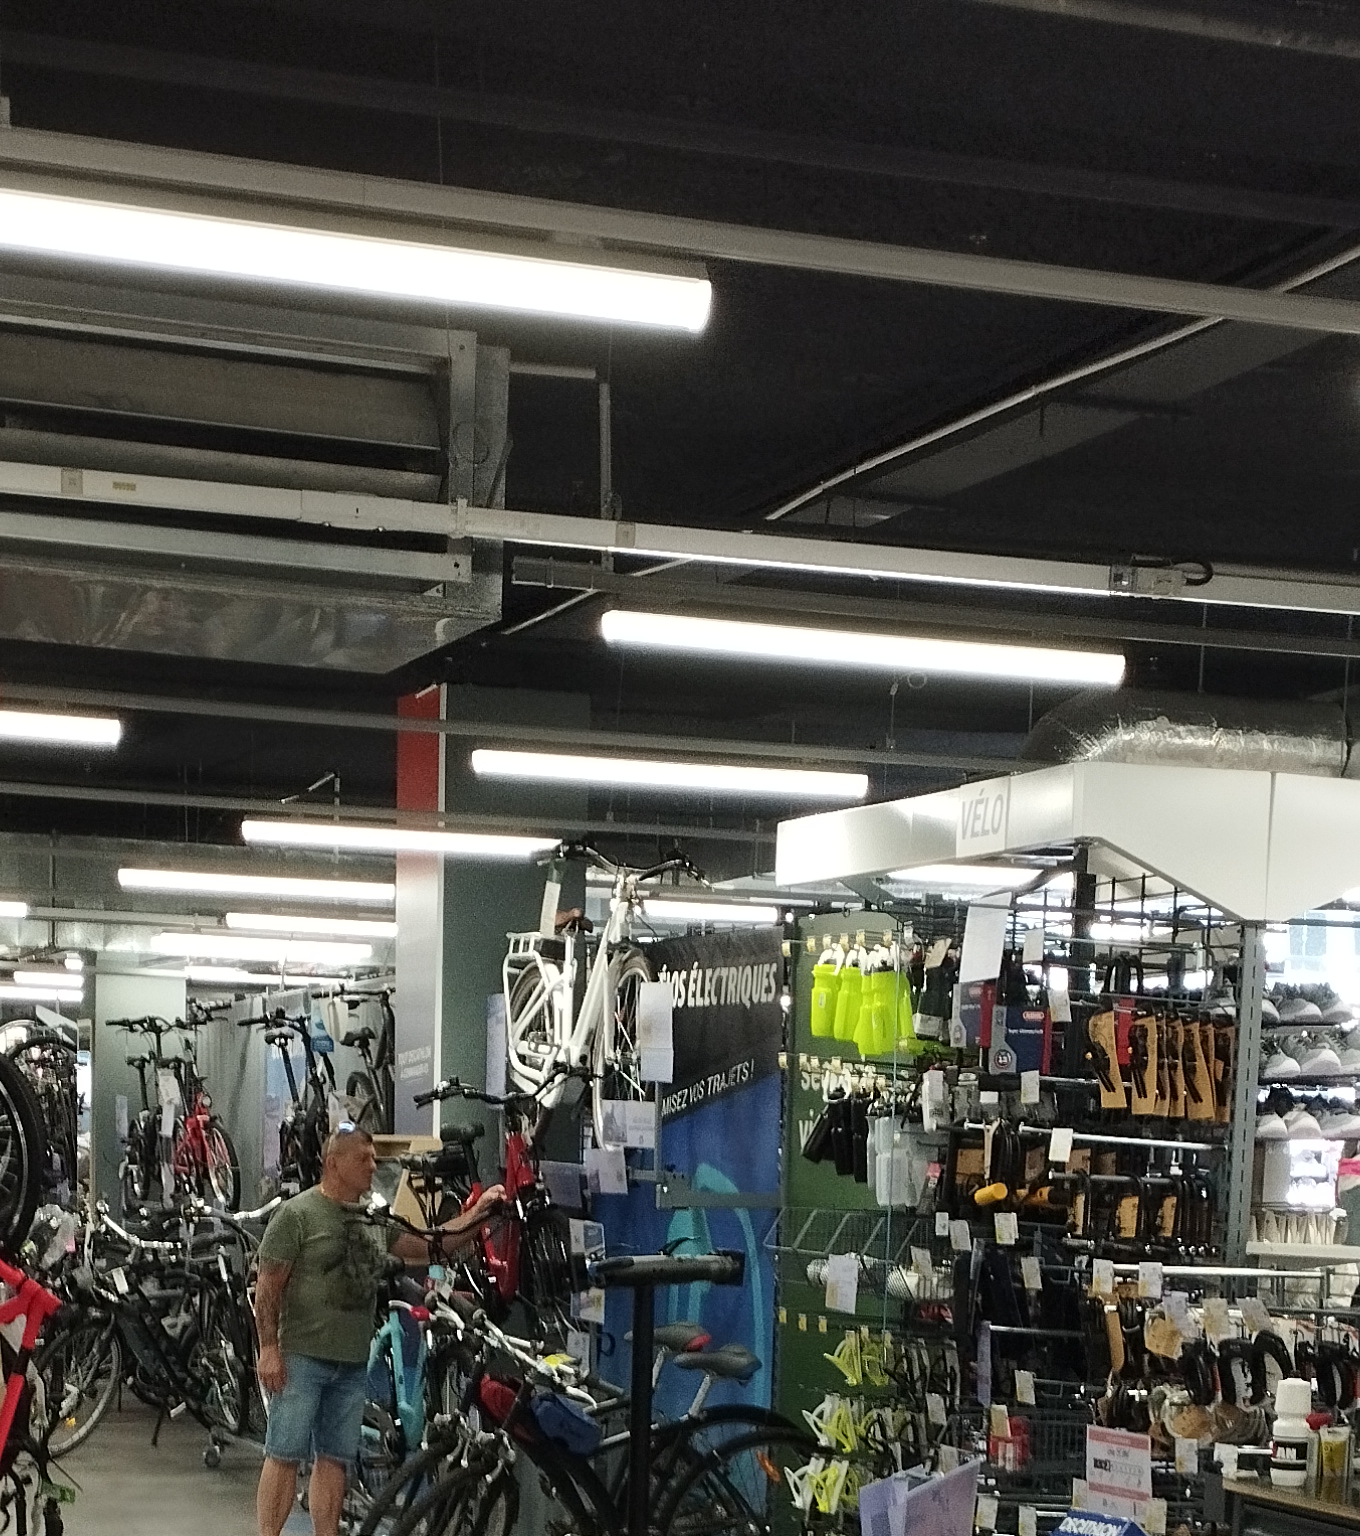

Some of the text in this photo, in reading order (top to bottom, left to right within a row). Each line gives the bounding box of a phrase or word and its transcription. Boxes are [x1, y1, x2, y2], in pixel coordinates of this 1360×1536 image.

[961, 787, 1004, 840] VÉLO
[687, 961, 778, 1009] ÉLECTRIQUES
[661, 1088, 688, 1117] MISEZ
[689, 1078, 706, 1103] VOS
[707, 1061, 750, 1097] TRAJETS
